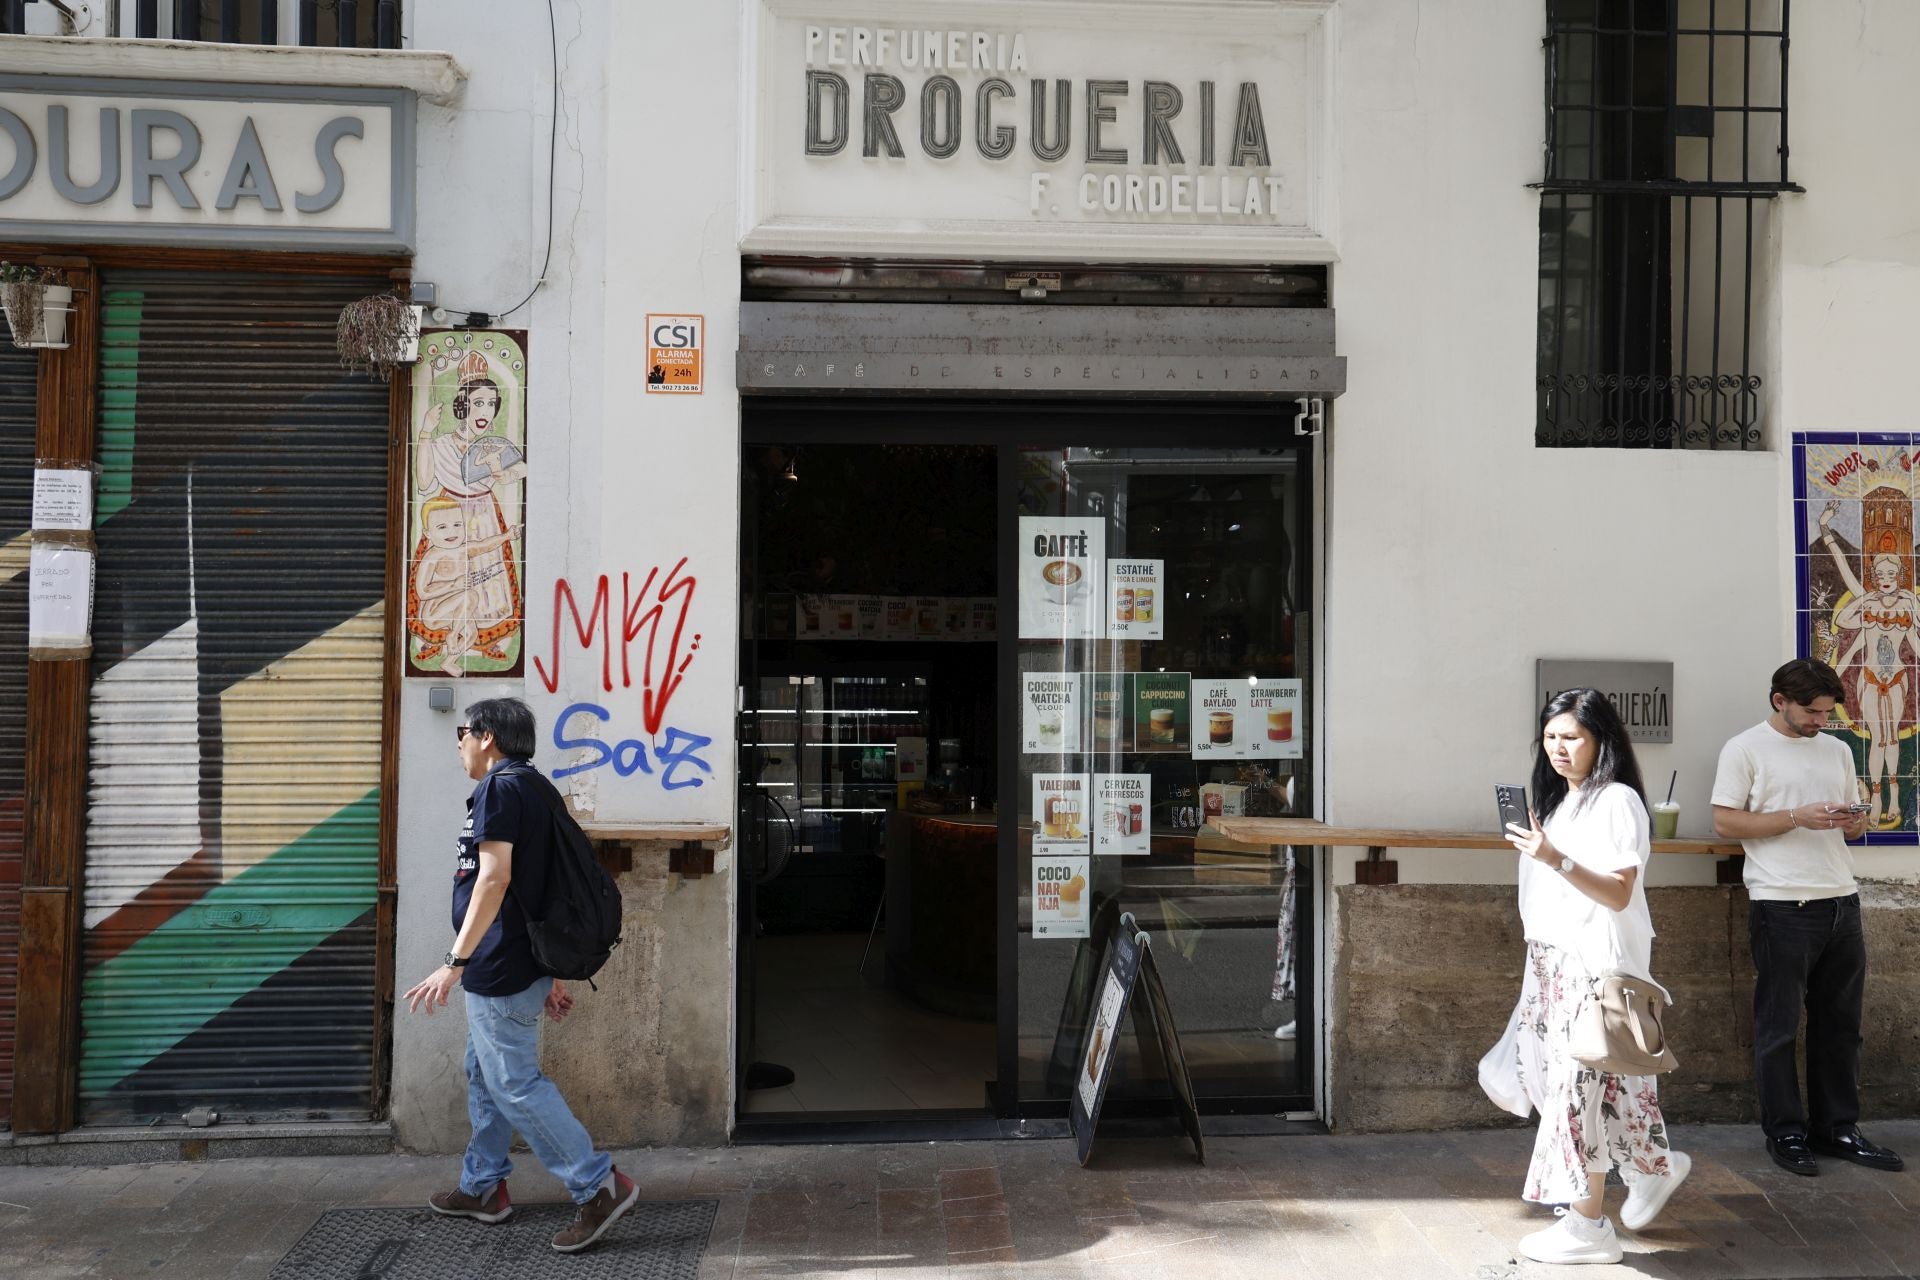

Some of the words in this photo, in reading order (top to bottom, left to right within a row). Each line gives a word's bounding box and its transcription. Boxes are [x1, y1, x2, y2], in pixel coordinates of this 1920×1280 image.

[804, 26, 1028, 73] PERFUMERIA
[804, 70, 1271, 168] DROGUERIA
[1030, 173, 1059, 215] F.
[1079, 173, 1285, 216] CORDELLAT
[653, 325, 695, 348] CSI
[656, 350, 694, 358] ALARMA
[673, 368, 692, 377] 24h
[763, 362, 865, 378] CAFÉ
[910, 366, 951, 378] DE
[994, 366, 1320, 381] ESPECIALIDAD
[1034, 530, 1088, 558] CAFFÈ
[1116, 563, 1154, 576] ESTATHÉ
[1027, 681, 1073, 692] COCONUT
[1030, 693, 1071, 704] MATCHA
[1140, 690, 1186, 700] CAPPUCCINO
[1209, 688, 1228, 698] CAFÉ
[1250, 689, 1297, 698] STRAWBERRY
[1203, 699, 1237, 708] BAYLADO
[1250, 699, 1273, 708] LATTE
[1608, 686, 1668, 726] UERÍA
[1028, 741, 1037, 749] 5€
[1252, 743, 1261, 751] 5€
[1104, 779, 1141, 790] CERVEZA
[1099, 791, 1104, 799] Y
[1105, 790, 1145, 799] REFRESCOS
[1037, 866, 1071, 881] COCO
[1037, 882, 1061, 896] NAR
[1038, 897, 1060, 911] NJA
[1038, 926, 1048, 934] 4€
